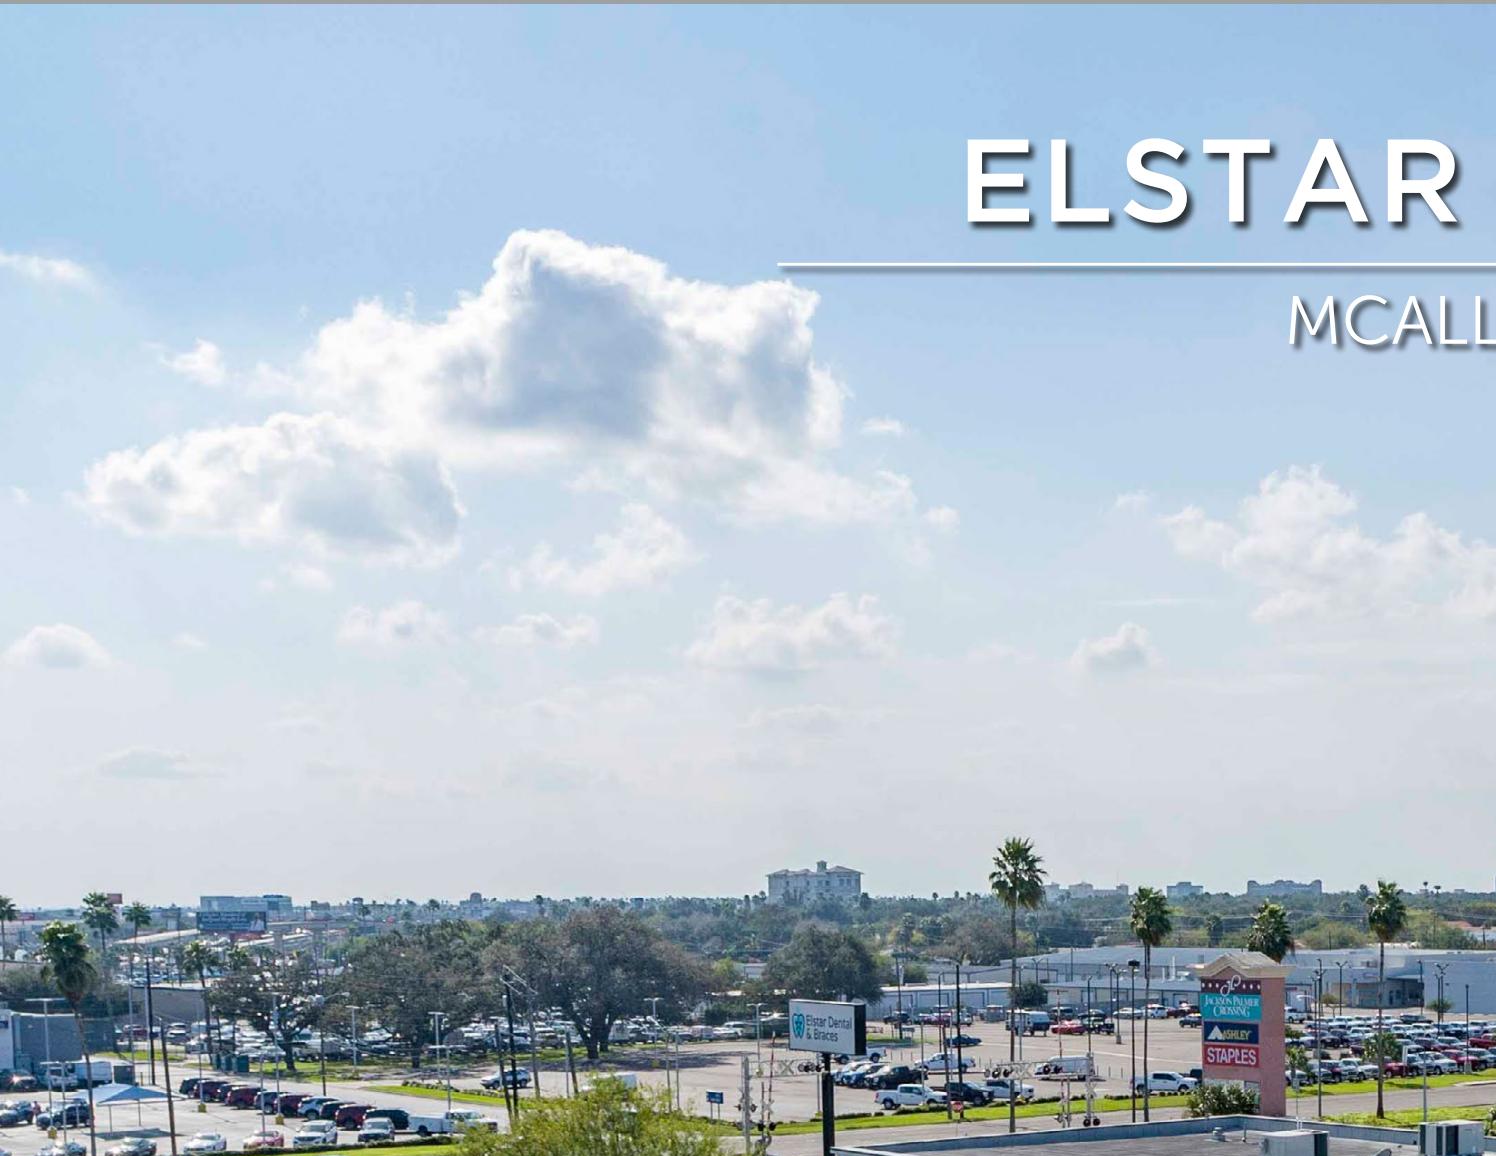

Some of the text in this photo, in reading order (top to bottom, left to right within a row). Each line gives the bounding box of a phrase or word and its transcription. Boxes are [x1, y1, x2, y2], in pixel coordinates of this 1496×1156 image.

[1203, 994, 1260, 1007] JACKSON PALMER
[1213, 1005, 1251, 1018] CROSSING
[806, 1014, 853, 1030] Elstar Dental
[813, 1029, 839, 1042] Braces
[1207, 1047, 1257, 1065] STAPLES
